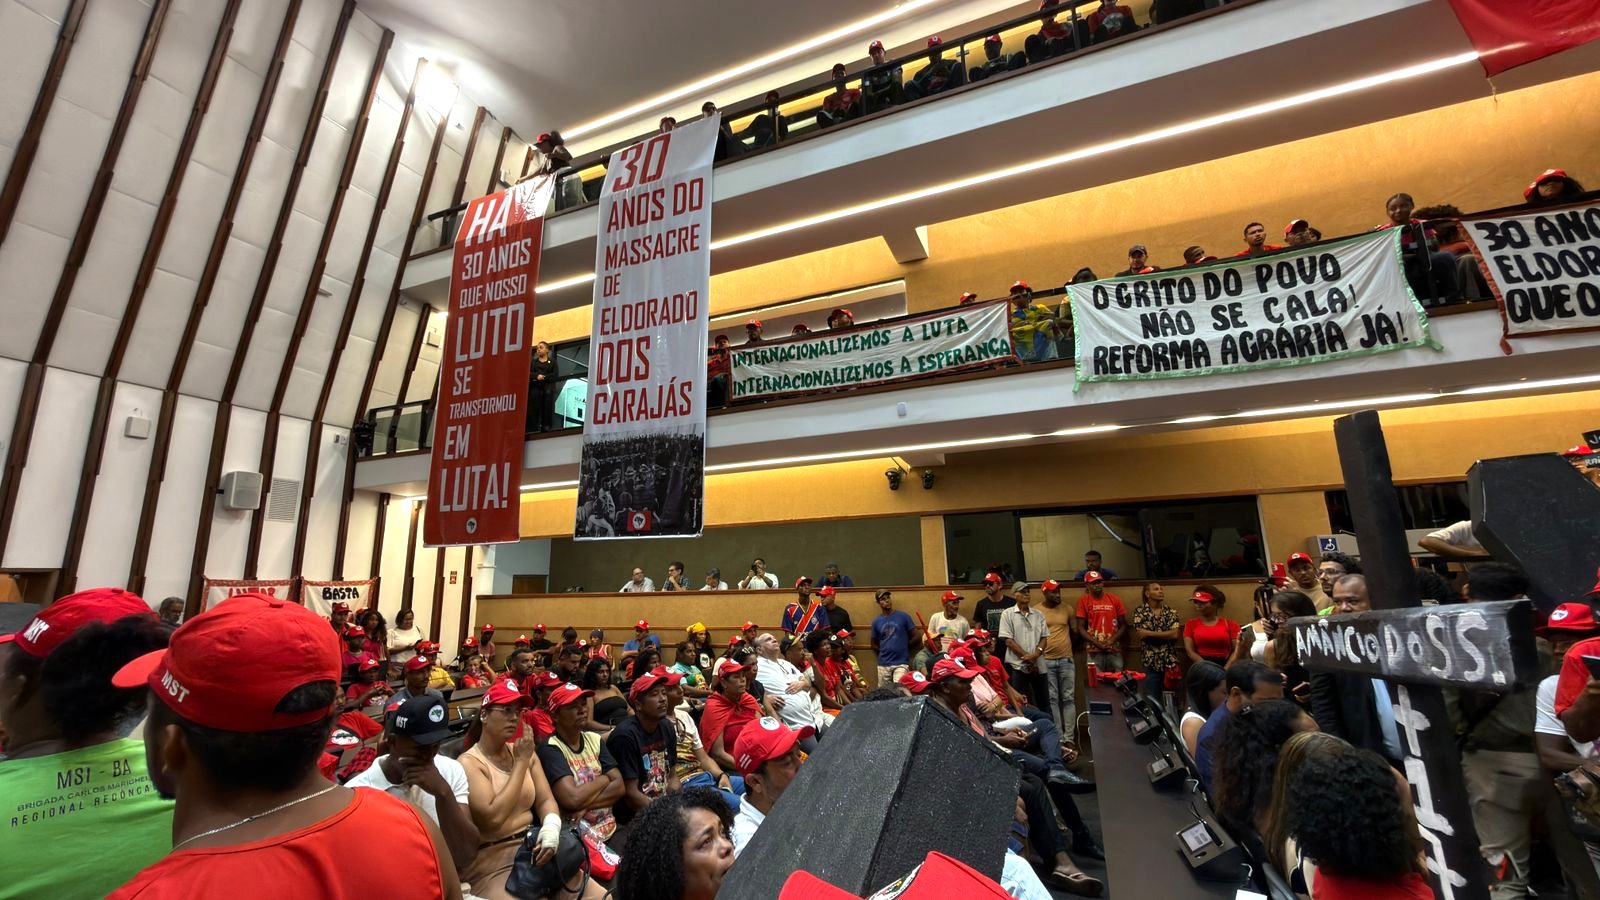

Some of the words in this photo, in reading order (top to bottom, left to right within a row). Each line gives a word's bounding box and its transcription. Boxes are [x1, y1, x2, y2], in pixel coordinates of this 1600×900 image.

[612, 133, 671, 193] 30
[607, 188, 665, 233] ANOS
[673, 177, 704, 217] DO
[605, 224, 700, 271] MASSACRE
[1474, 220, 1531, 251] 30
[462, 251, 483, 280] 30
[487, 238, 532, 275] ANOS
[459, 285, 483, 309] QUE
[485, 274, 527, 303] NOSSO
[603, 273, 621, 298] DE
[1093, 285, 1109, 310] O
[1115, 277, 1196, 309] GRITO
[1203, 268, 1243, 300] DO
[1255, 253, 1341, 293] POVO
[455, 302, 525, 362] LUTO
[600, 291, 698, 336] ELDORADO
[1140, 308, 1195, 339] NÃO
[1211, 302, 1248, 331] SE
[1263, 284, 1359, 323] CALA!
[733, 330, 891, 368] INTERNACIONALIZEMOS
[902, 326, 914, 342] A
[922, 316, 970, 341] LUTA
[1093, 338, 1211, 375] REFORMA
[1220, 321, 1349, 365] AGRÁRIA
[1359, 304, 1408, 348] JÁ!
[452, 366, 473, 396] SE
[596, 336, 650, 385] DOS
[734, 360, 894, 396] INTERNACIONALIZEMOS
[901, 356, 912, 373] A
[449, 393, 516, 420] TRANSFORMOU
[593, 376, 692, 425] CARAJÁS
[443, 424, 471, 460] EM
[439, 462, 511, 513] LUTA!
[322, 587, 360, 600] BASTA
[23, 617, 50, 643] MST
[161, 669, 190, 703] MST
[113, 759, 131, 777] BA
[11, 801, 84, 827] REGIONAL
[17, 795, 64, 811] BRIGADA
[67, 786, 105, 800] CARLOS
